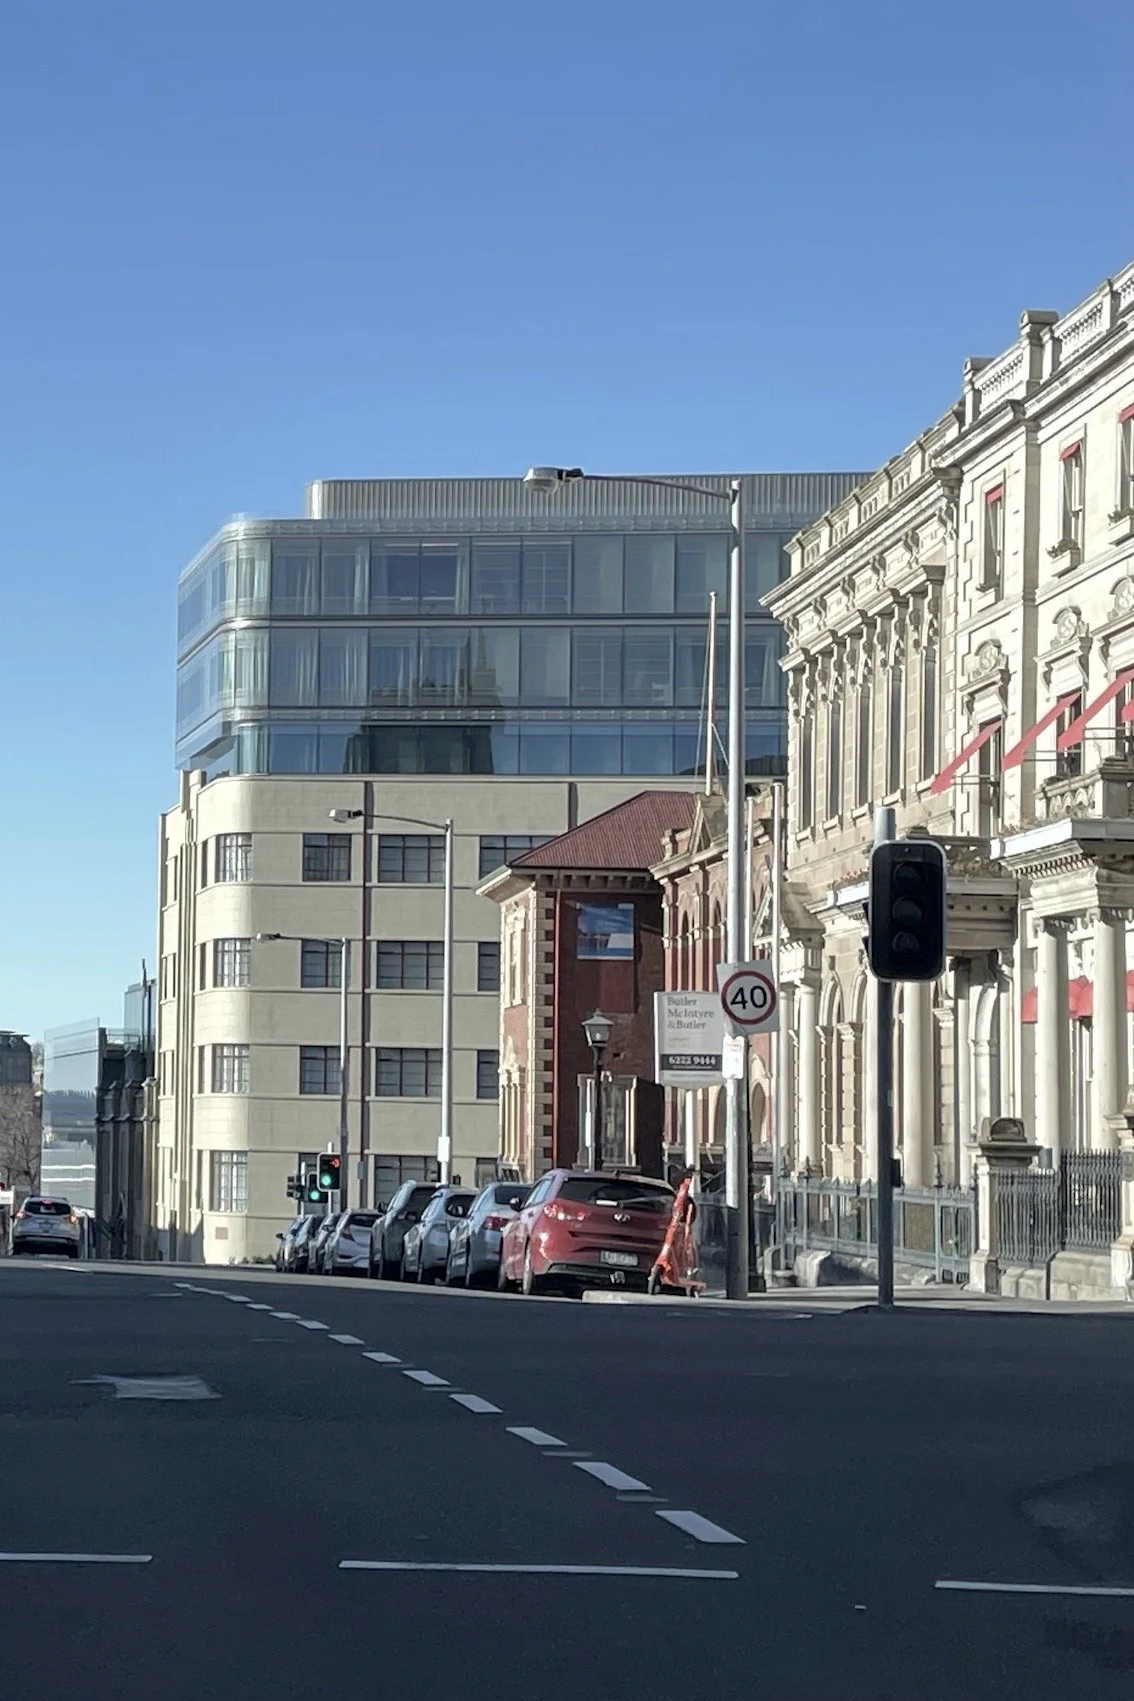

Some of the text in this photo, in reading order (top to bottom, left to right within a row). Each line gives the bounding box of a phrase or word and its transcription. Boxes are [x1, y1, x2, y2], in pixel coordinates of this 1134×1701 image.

[667, 996, 697, 1006] Butler
[730, 985, 767, 1010] 40
[667, 1008, 714, 1020] McIntyre
[668, 1056, 692, 1065] 6222
